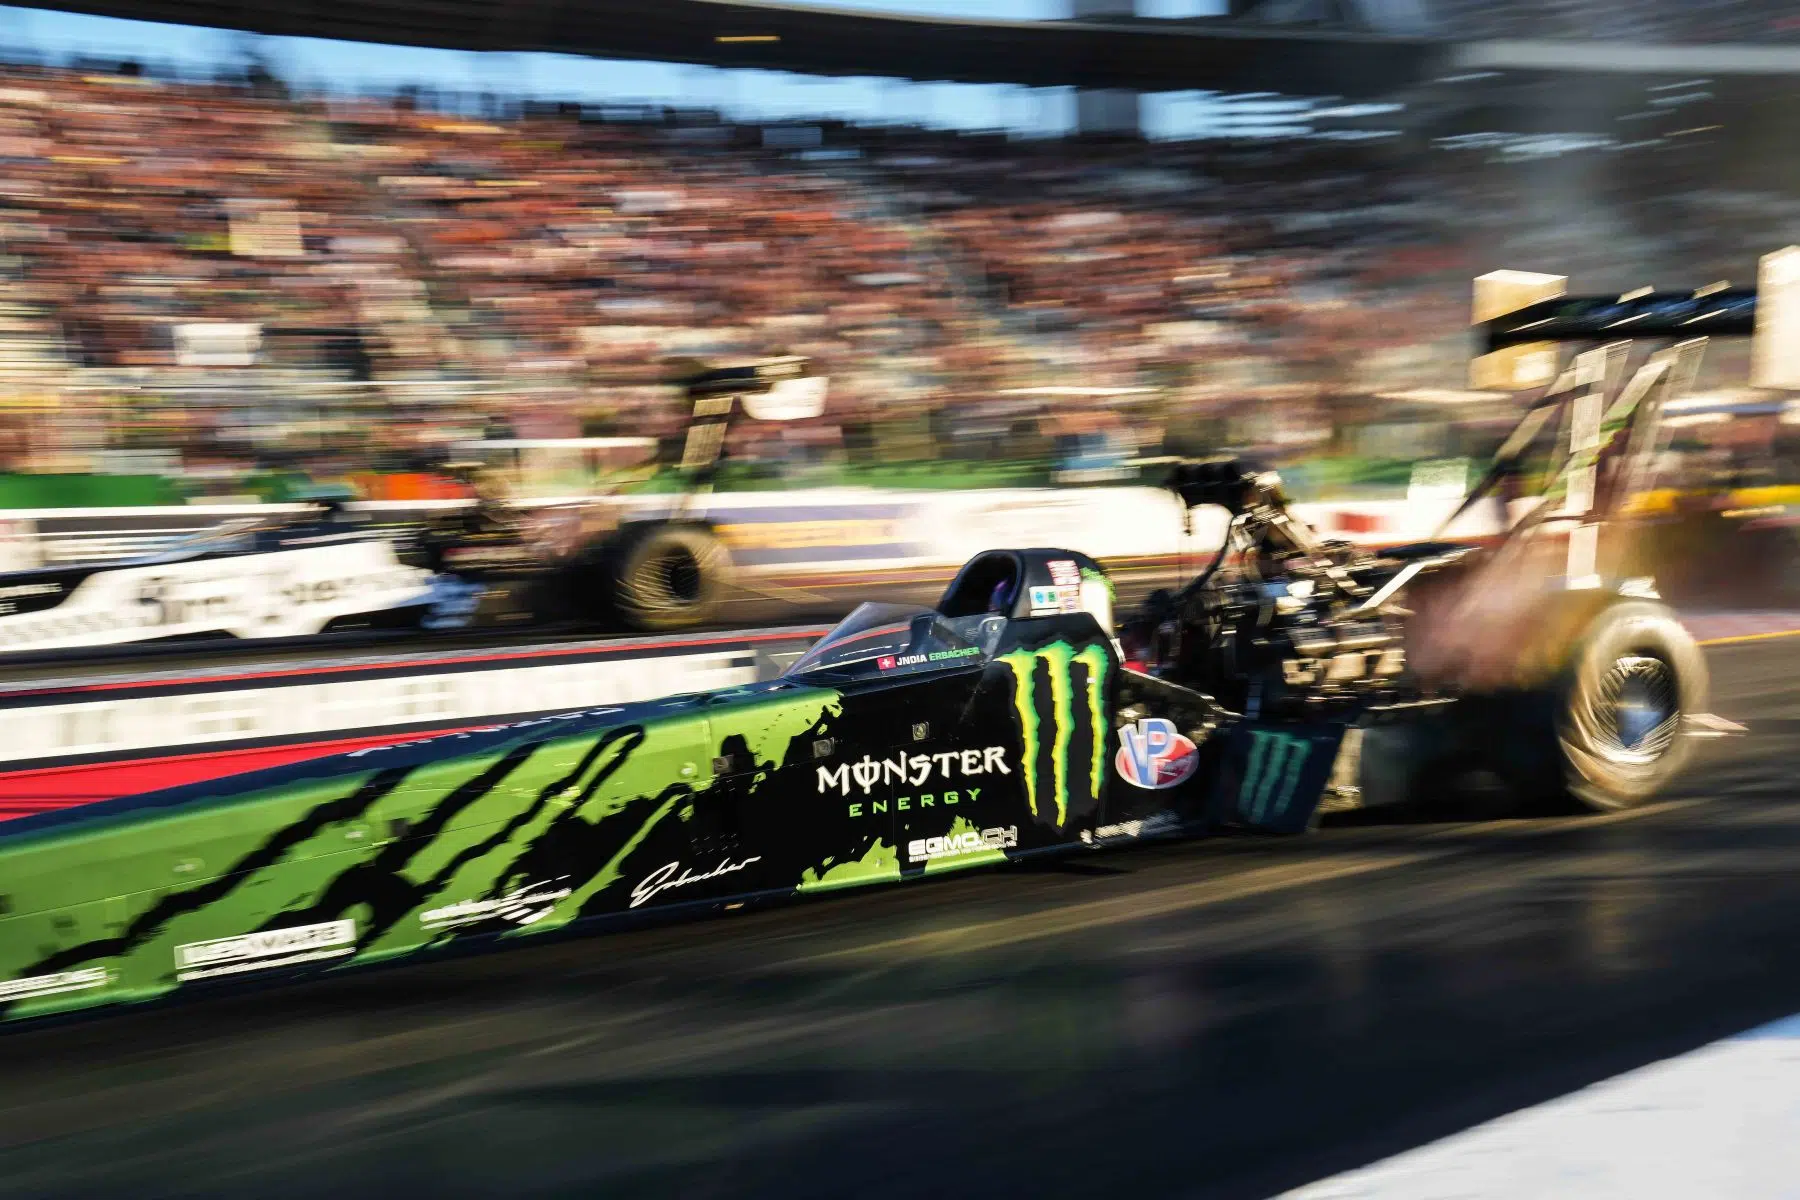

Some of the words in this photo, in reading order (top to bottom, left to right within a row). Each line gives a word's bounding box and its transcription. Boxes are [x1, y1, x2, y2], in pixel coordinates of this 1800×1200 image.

[896, 654, 927, 666] JNDIA
[928, 646, 980, 661] ERBACHER
[816, 746, 1011, 796] MONSTER
[1117, 718, 1178, 787] VP
[849, 788, 981, 817] ENERGY
